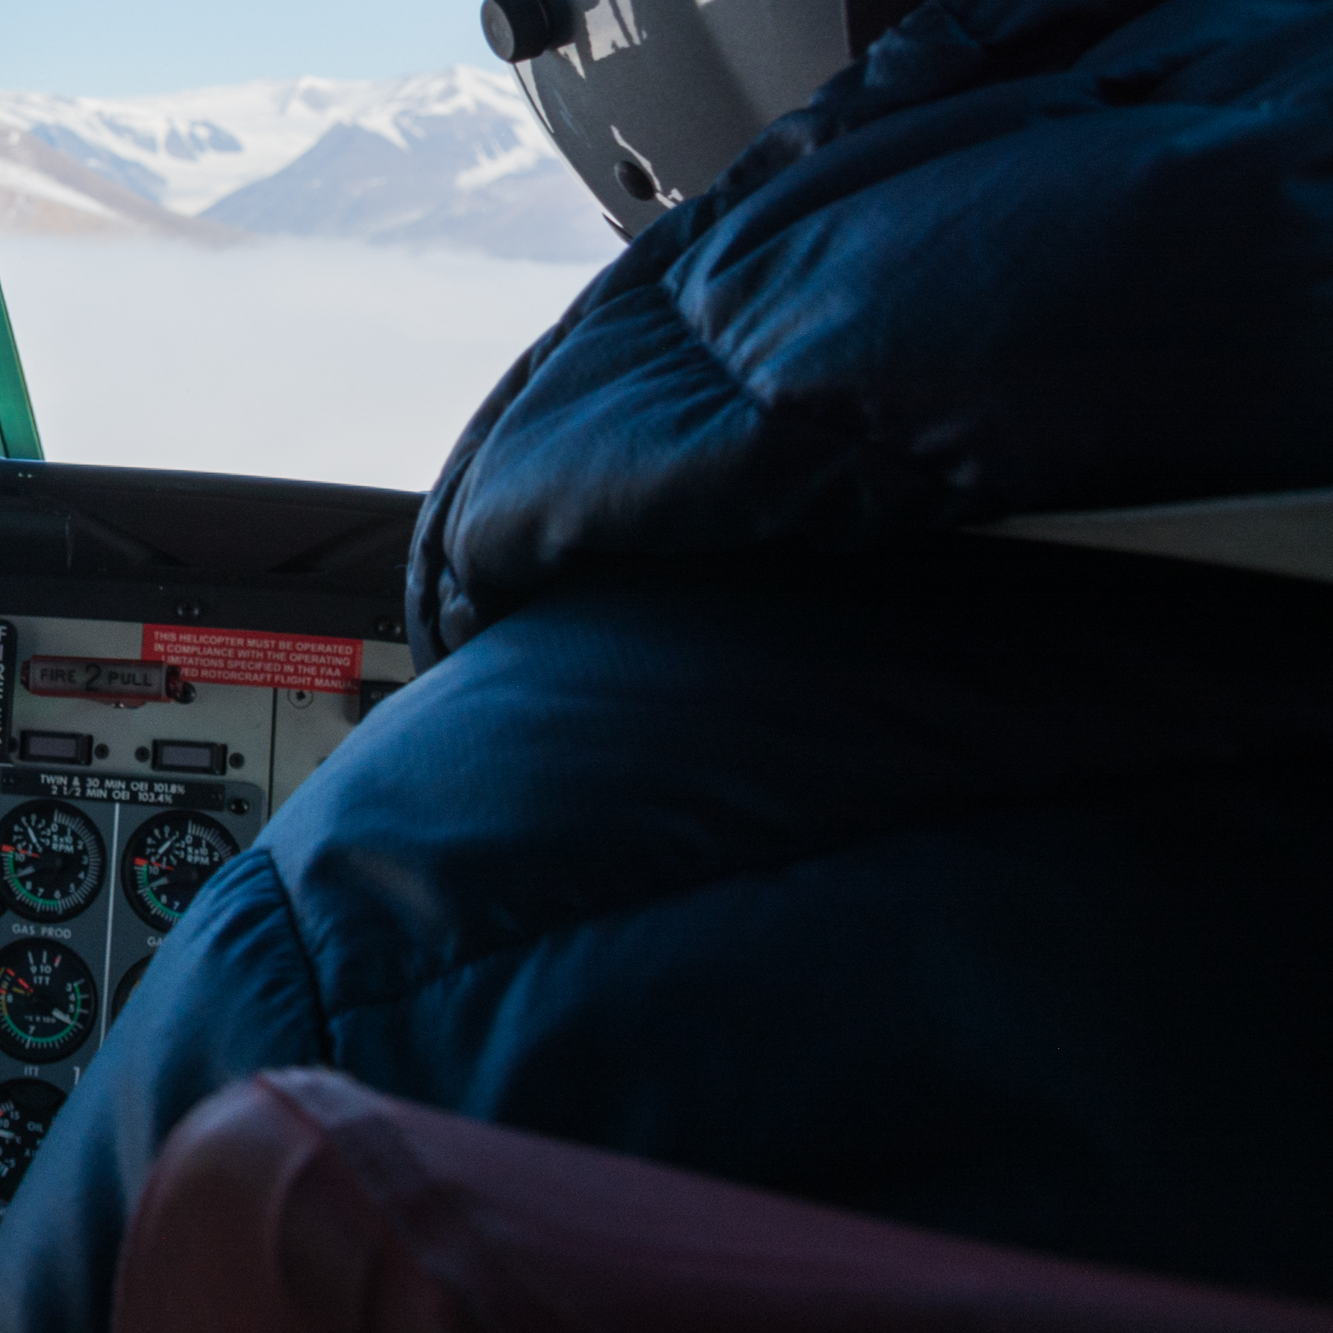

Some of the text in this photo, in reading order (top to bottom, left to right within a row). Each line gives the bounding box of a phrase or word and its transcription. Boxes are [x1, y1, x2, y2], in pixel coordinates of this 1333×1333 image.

[154, 632, 352, 654] THIS HELICOPTER MUST BE OPERATED
[155, 643, 350, 666] IN COMPLIANCE WITH THE OPERATING
[41, 663, 151, 691] FIRE 2 PULL
[227, 659, 281, 673] SPECIFIED
[285, 663, 295, 674] IN
[298, 664, 316, 675] THE
[321, 666, 341, 677] FAA
[201, 669, 271, 683] ROTORCRAFT
[274, 674, 311, 686] FLIGHT
[40, 773, 68, 786] TWIN
[72, 777, 80, 786] &
[86, 777, 99, 787] 30
[104, 779, 125, 790] MIN
[130, 782, 148, 791] OEI
[51, 786, 173, 804] 2 1/2 MIN OEI 103.4%
[12, 924, 72, 939] GAS PROD
